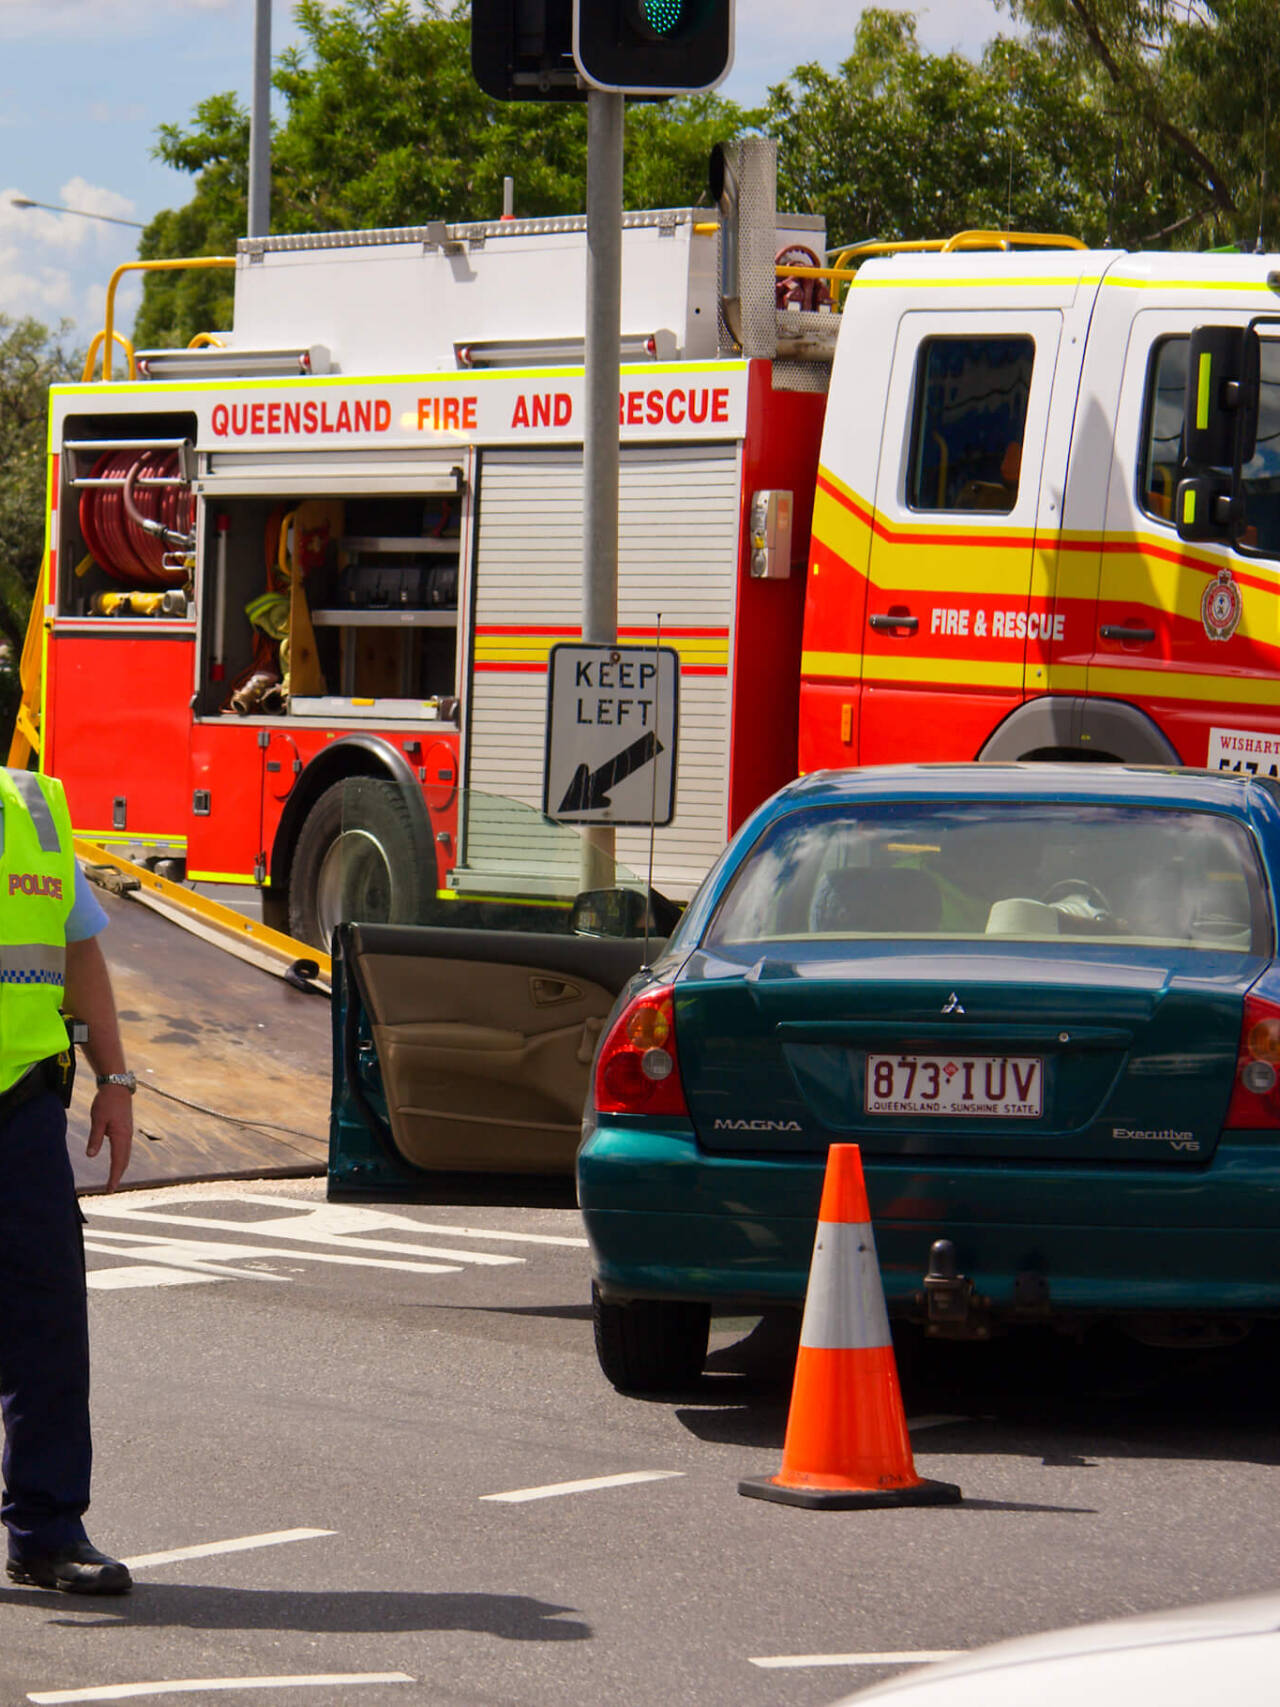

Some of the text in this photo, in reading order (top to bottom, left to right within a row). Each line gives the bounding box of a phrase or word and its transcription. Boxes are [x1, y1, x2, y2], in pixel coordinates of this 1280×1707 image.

[211, 399, 392, 437] QUEENSLAND
[417, 396, 478, 430] FIRE
[511, 393, 573, 429] AND
[931, 607, 1066, 642] FIRE & RESCUE
[576, 660, 657, 688] KEEP
[577, 698, 653, 726] LEFT
[1220, 735, 1280, 755] WISHART
[8, 873, 63, 900] POLICE
[874, 1102, 1035, 1115] QUEENSLAND SUNSHINE STATE
[713, 1119, 803, 1131] MAGNA
[1112, 1128, 1193, 1141] Executive
[1170, 1141, 1201, 1152] V6
